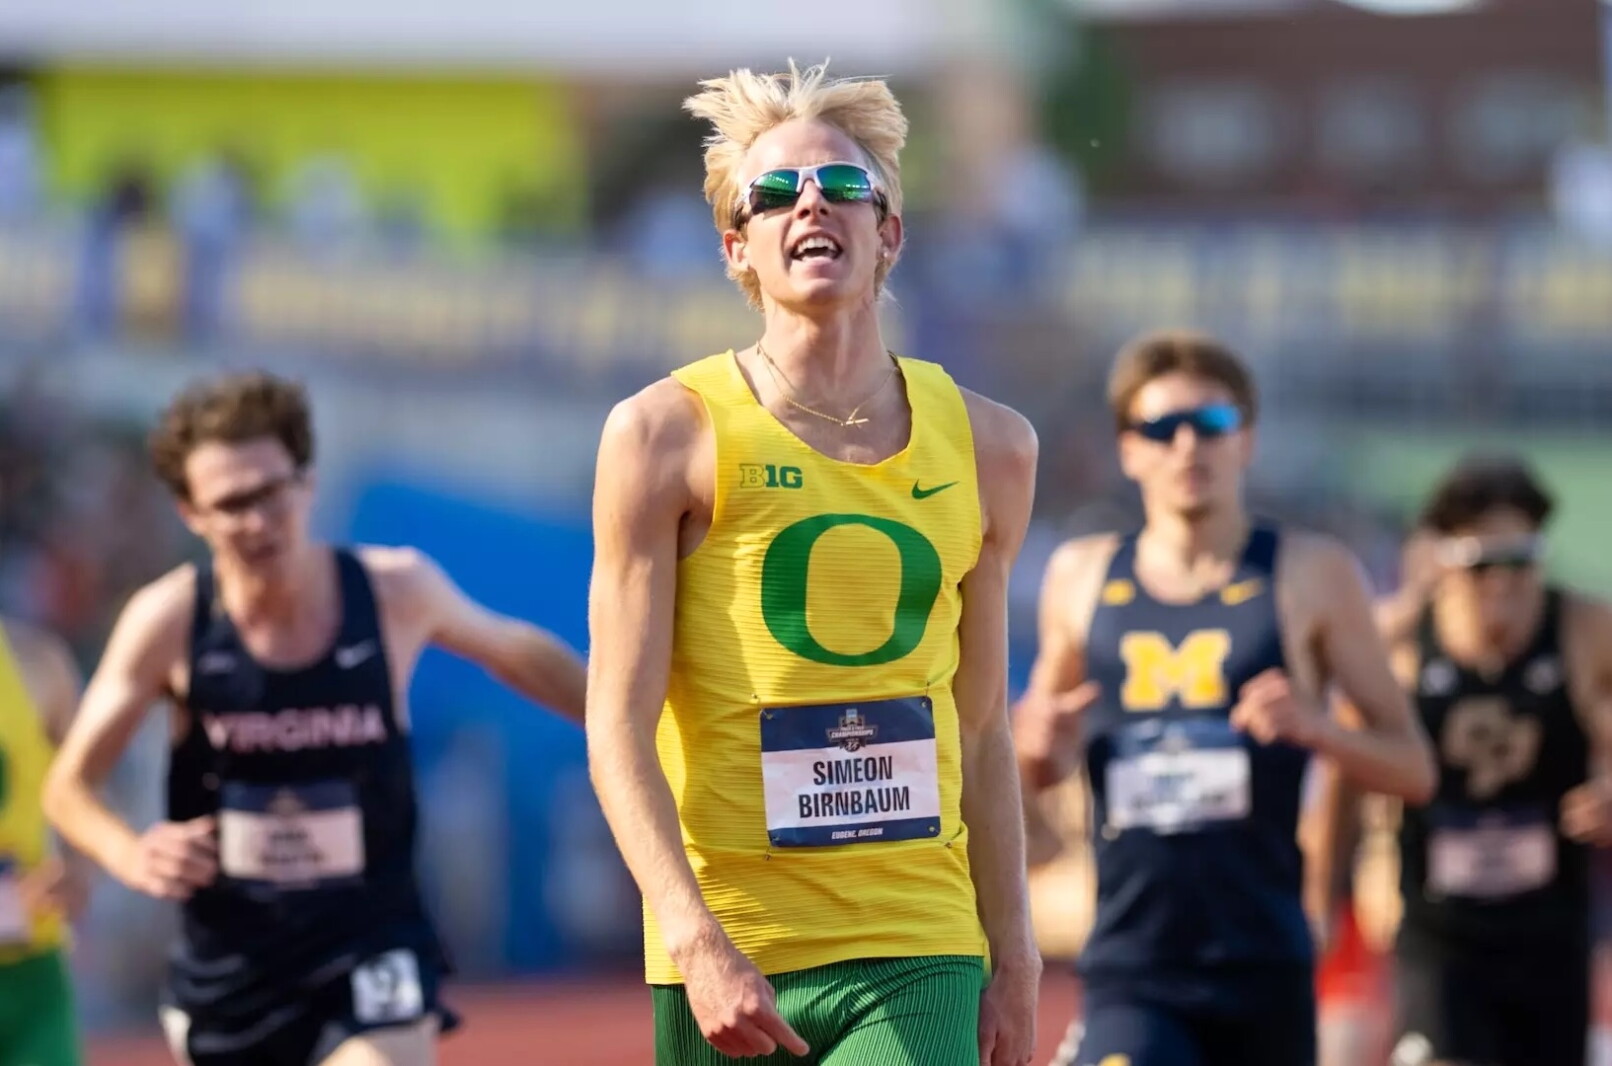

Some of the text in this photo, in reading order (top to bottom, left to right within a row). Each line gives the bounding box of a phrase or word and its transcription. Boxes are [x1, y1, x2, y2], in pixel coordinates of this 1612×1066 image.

[760, 513, 943, 667] O
[1119, 628, 1232, 713] M
[202, 704, 388, 752] VIRGINIA
[812, 755, 893, 786] SIMEON
[798, 786, 911, 818] BIRNBAUM
